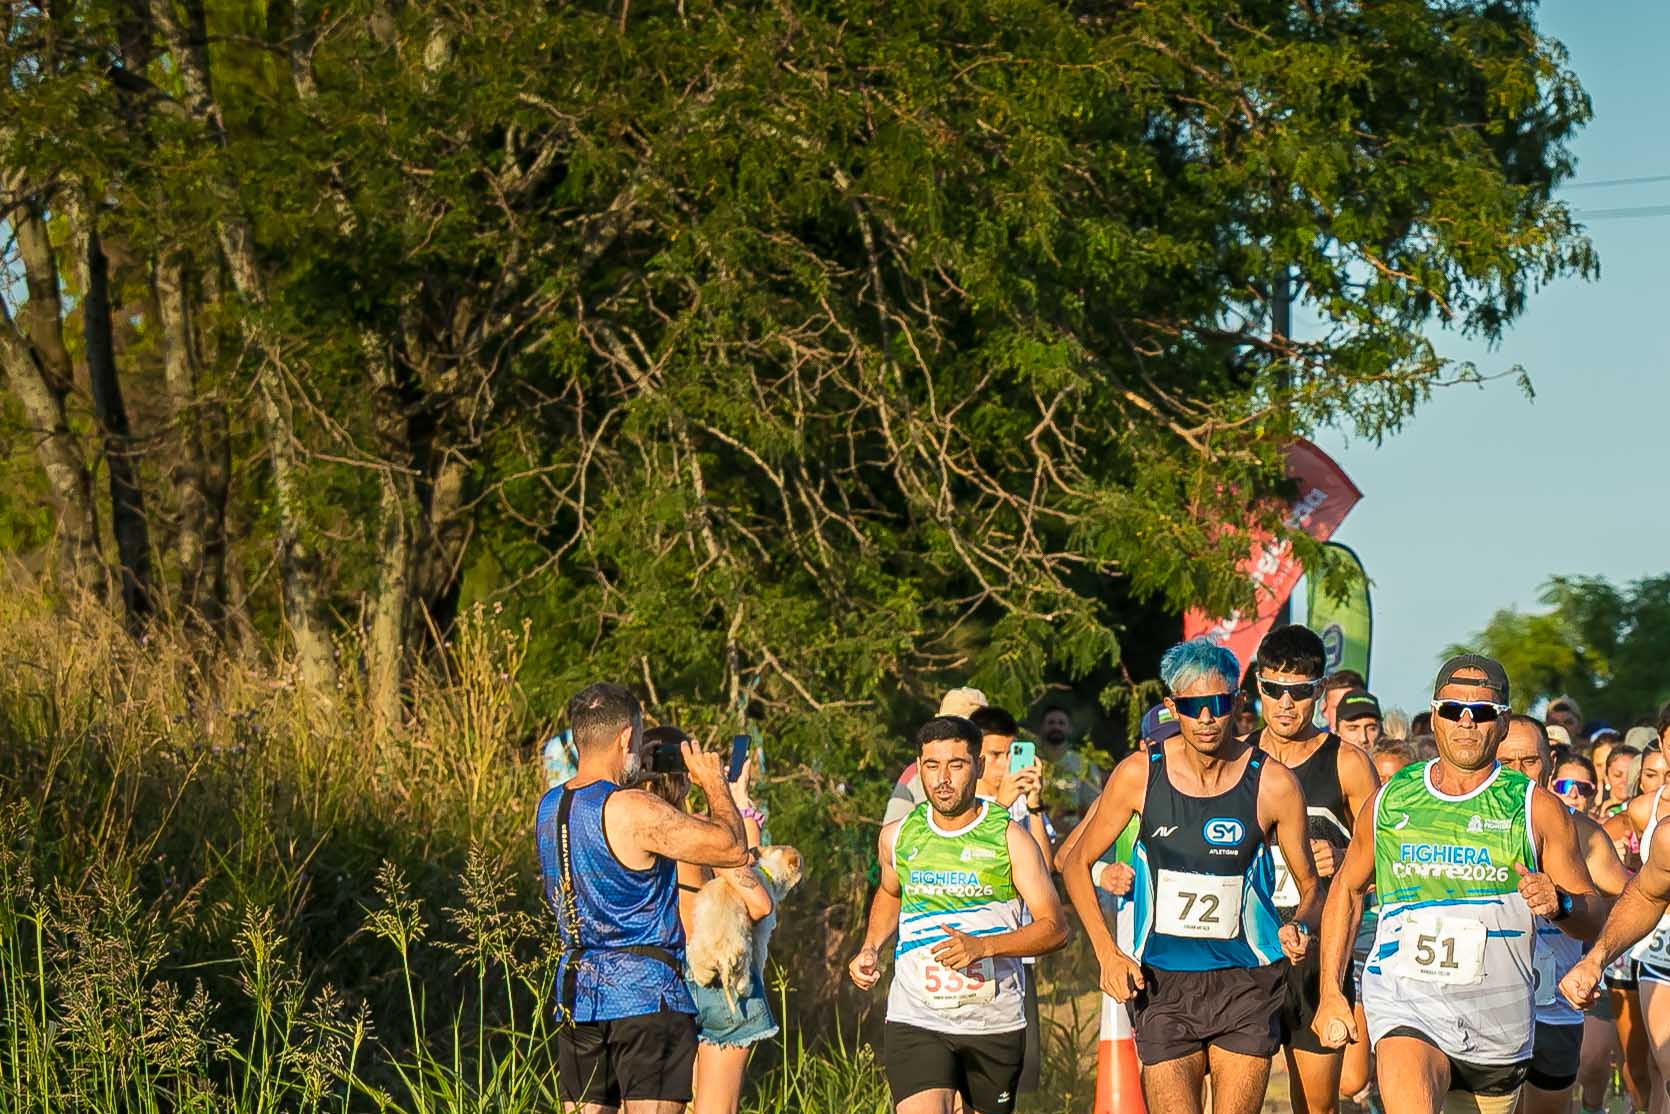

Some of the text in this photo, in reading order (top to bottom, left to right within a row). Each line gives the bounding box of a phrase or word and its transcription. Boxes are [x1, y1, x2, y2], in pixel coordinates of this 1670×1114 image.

[1399, 843, 1492, 866] FIGHIERA
[910, 870, 980, 887] FIGHIERA
[1178, 891, 1220, 923] 72
[1415, 933, 1459, 969] 51
